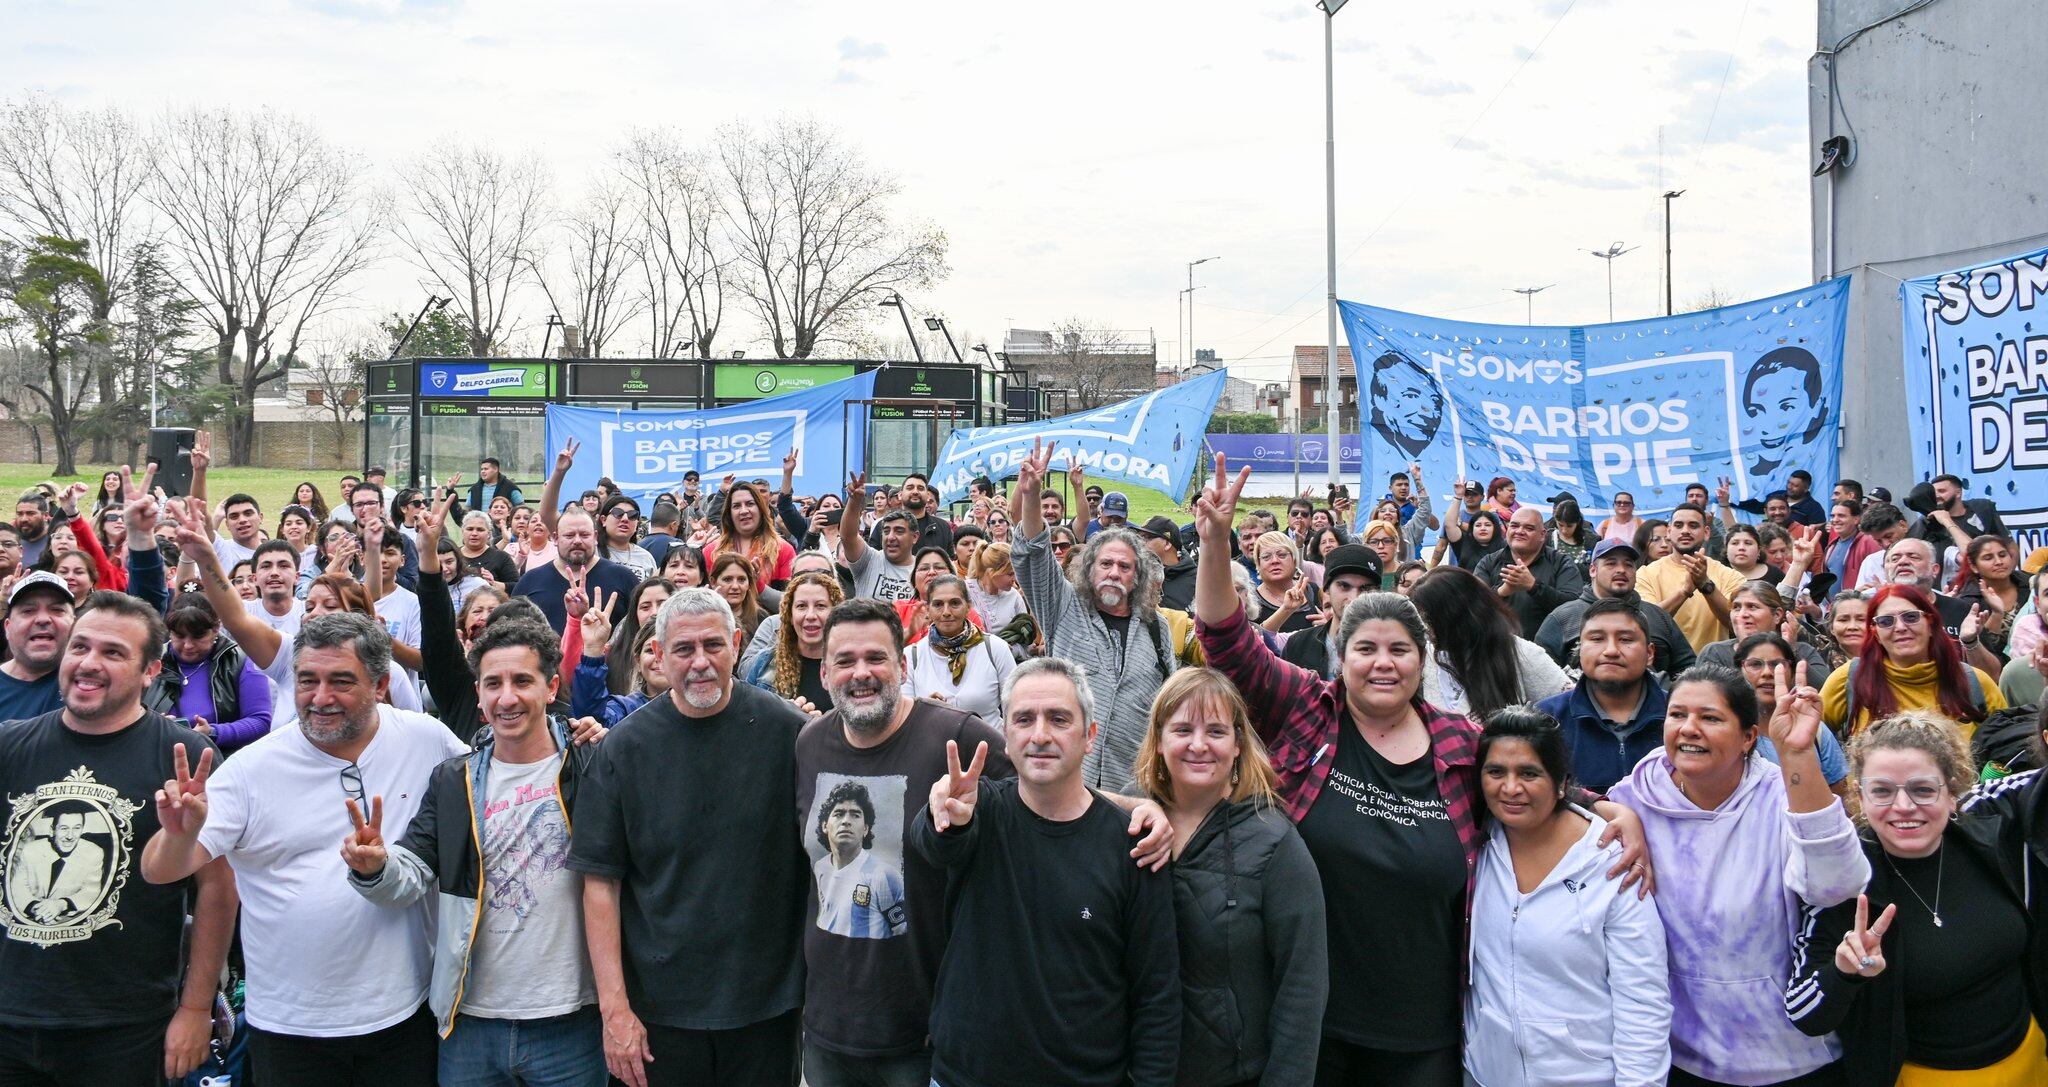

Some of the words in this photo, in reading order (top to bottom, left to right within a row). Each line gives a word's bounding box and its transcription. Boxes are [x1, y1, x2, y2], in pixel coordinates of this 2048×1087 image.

[460, 380, 484, 388] DELFO
[485, 376, 520, 386] CABRERA
[1481, 399, 1690, 438] BARRIOS
[635, 431, 773, 454] BARRIOS
[1969, 394, 2048, 474] DE
[635, 453, 694, 474] DE
[706, 449, 771, 471] PIE
[990, 448, 1028, 473] DE
[1489, 434, 1579, 486] DE
[1591, 438, 1700, 487] PIE
[38, 785, 67, 798] SEAN
[69, 785, 116, 801] ETERNOS
[1328, 779, 1368, 803] POLÍTICA
[1369, 795, 1375, 804] E
[1376, 799, 1451, 821] INDEPENDENCIA
[1329, 767, 1365, 790] JUSTICIA
[1401, 795, 1446, 809] SOBERAN
[1355, 804, 1419, 827] ECONÓMICA.
[9, 925, 29, 938] LOS
[32, 926, 87, 941] LAURELES
